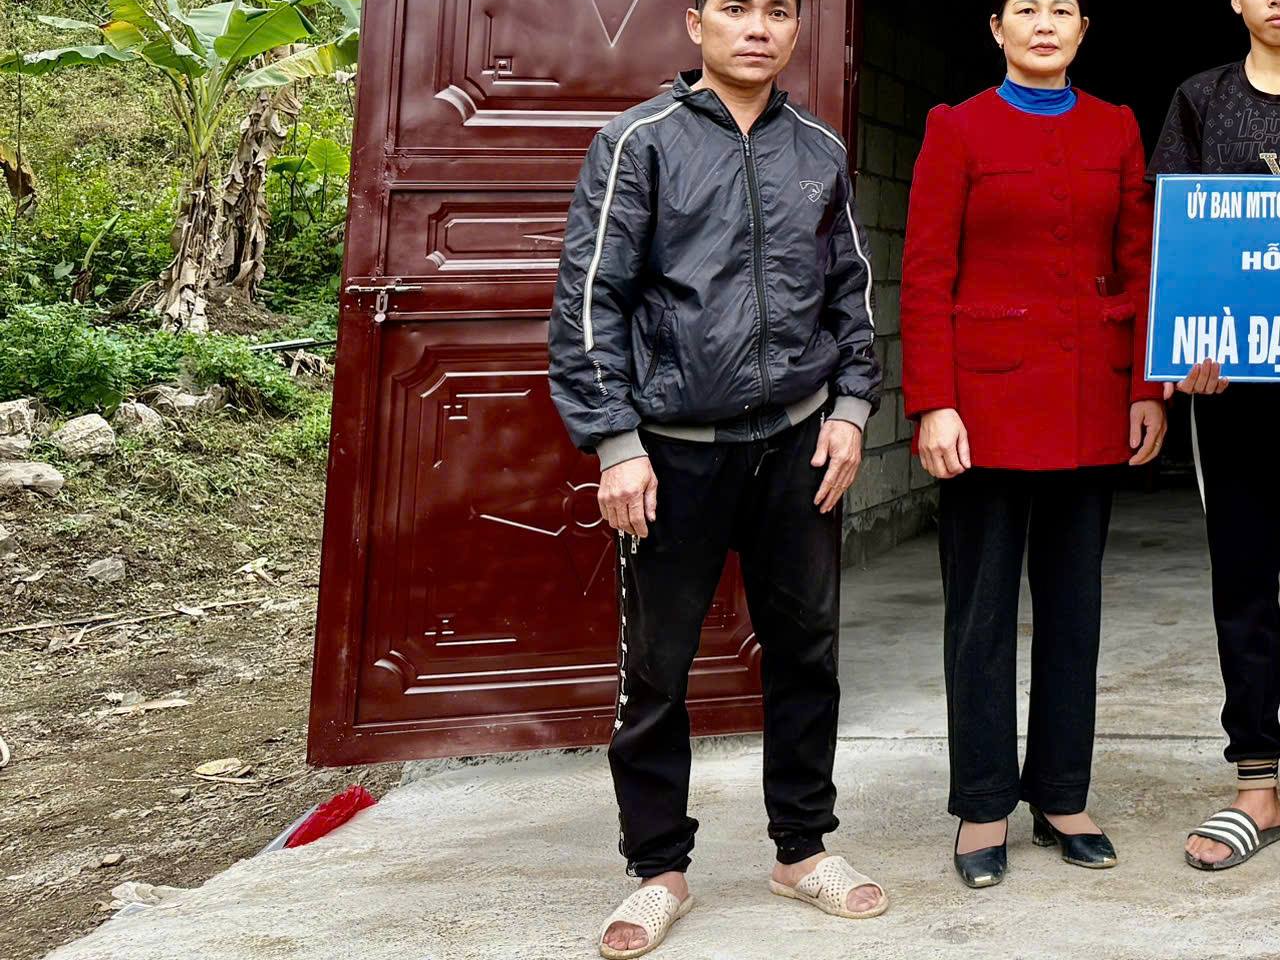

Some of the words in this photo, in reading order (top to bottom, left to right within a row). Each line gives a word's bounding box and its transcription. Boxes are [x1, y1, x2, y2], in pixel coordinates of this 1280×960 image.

[1187, 183, 1208, 219] ỦY
[1210, 191, 1242, 219] BAN
[1171, 306, 1239, 365] NHÀ
